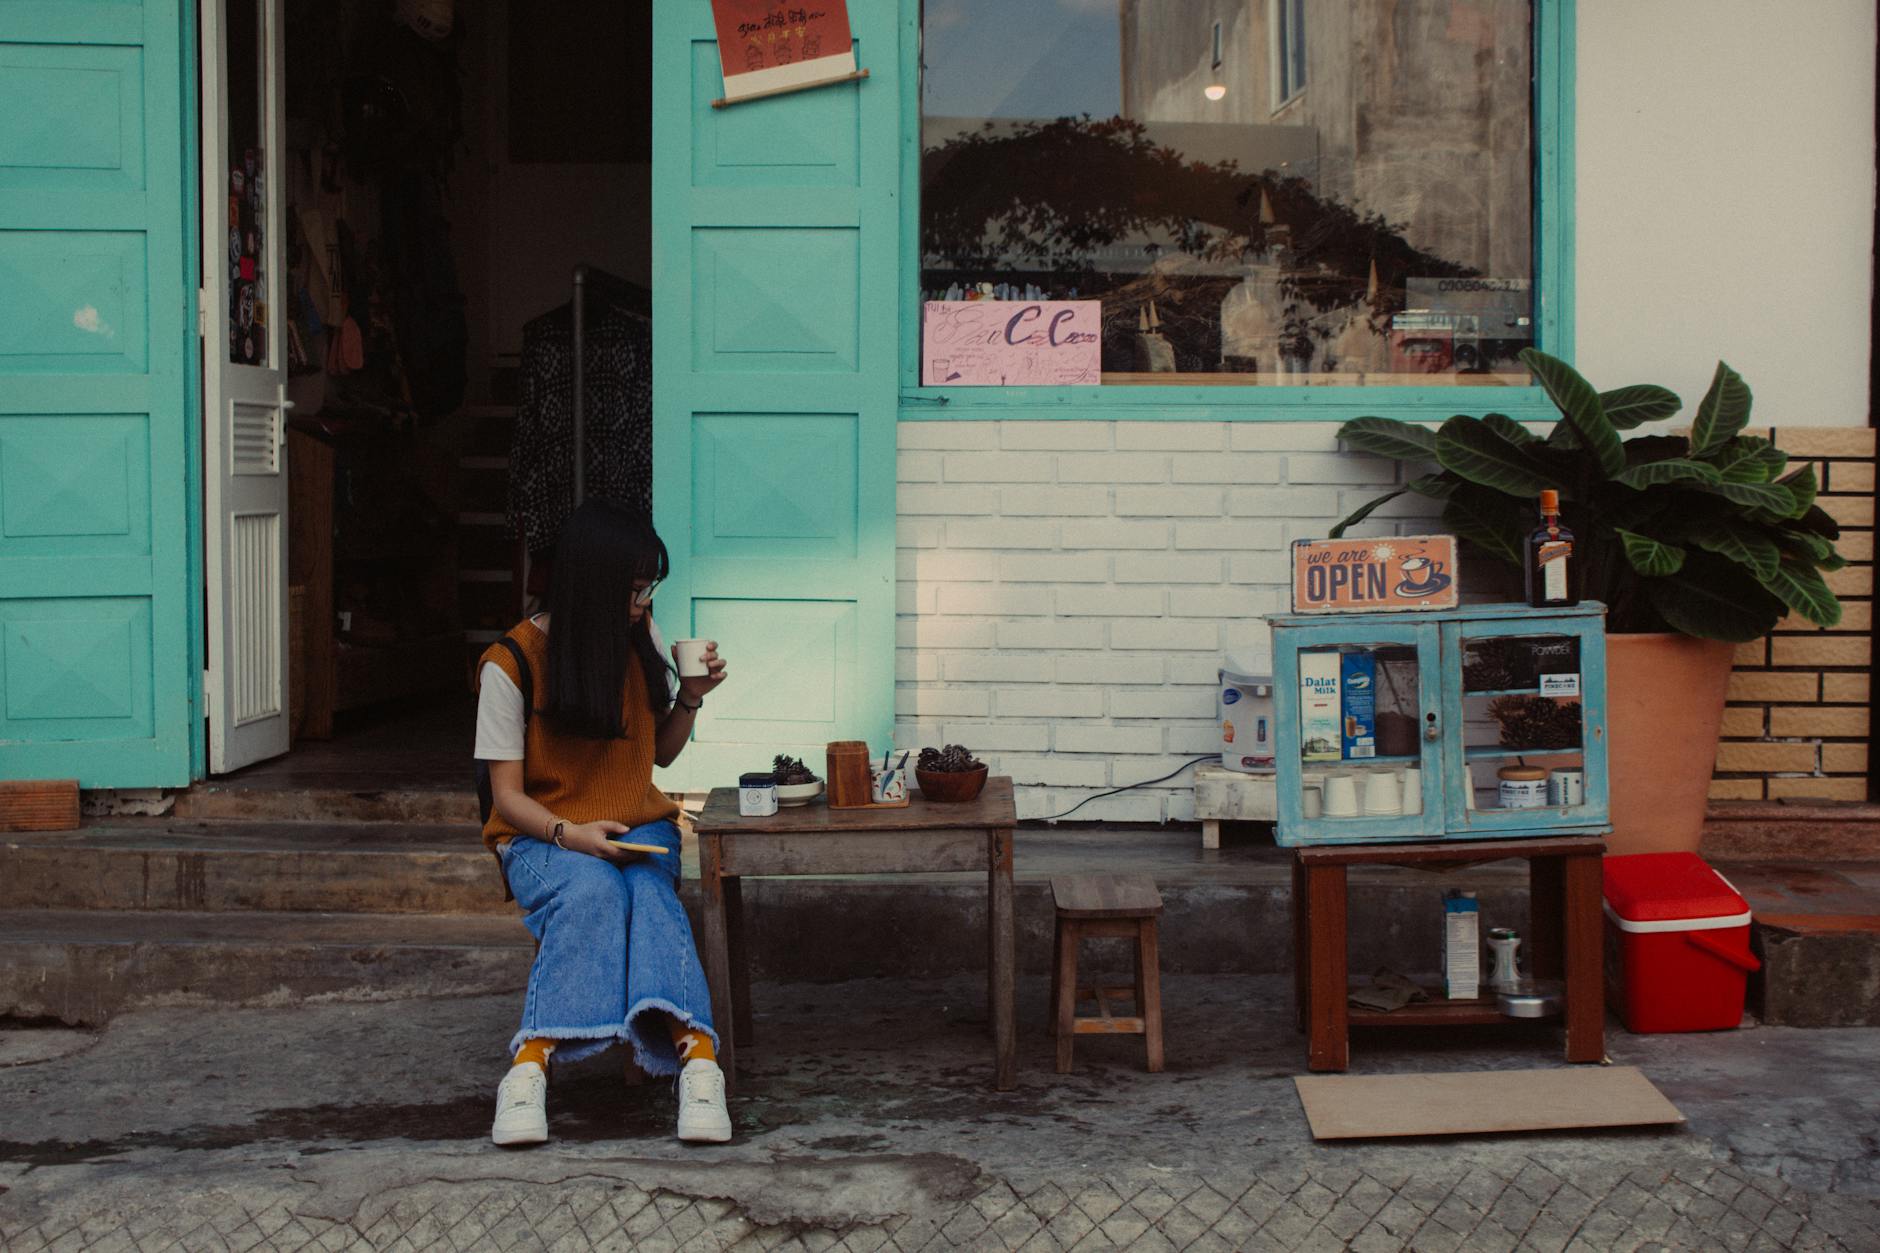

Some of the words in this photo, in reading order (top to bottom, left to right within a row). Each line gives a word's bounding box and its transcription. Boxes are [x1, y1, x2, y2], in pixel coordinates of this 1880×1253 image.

[1307, 552, 1332, 565] we
[1337, 549, 1369, 563] are
[1307, 561, 1387, 602] OPEN
[1305, 677, 1337, 687] Dalat
